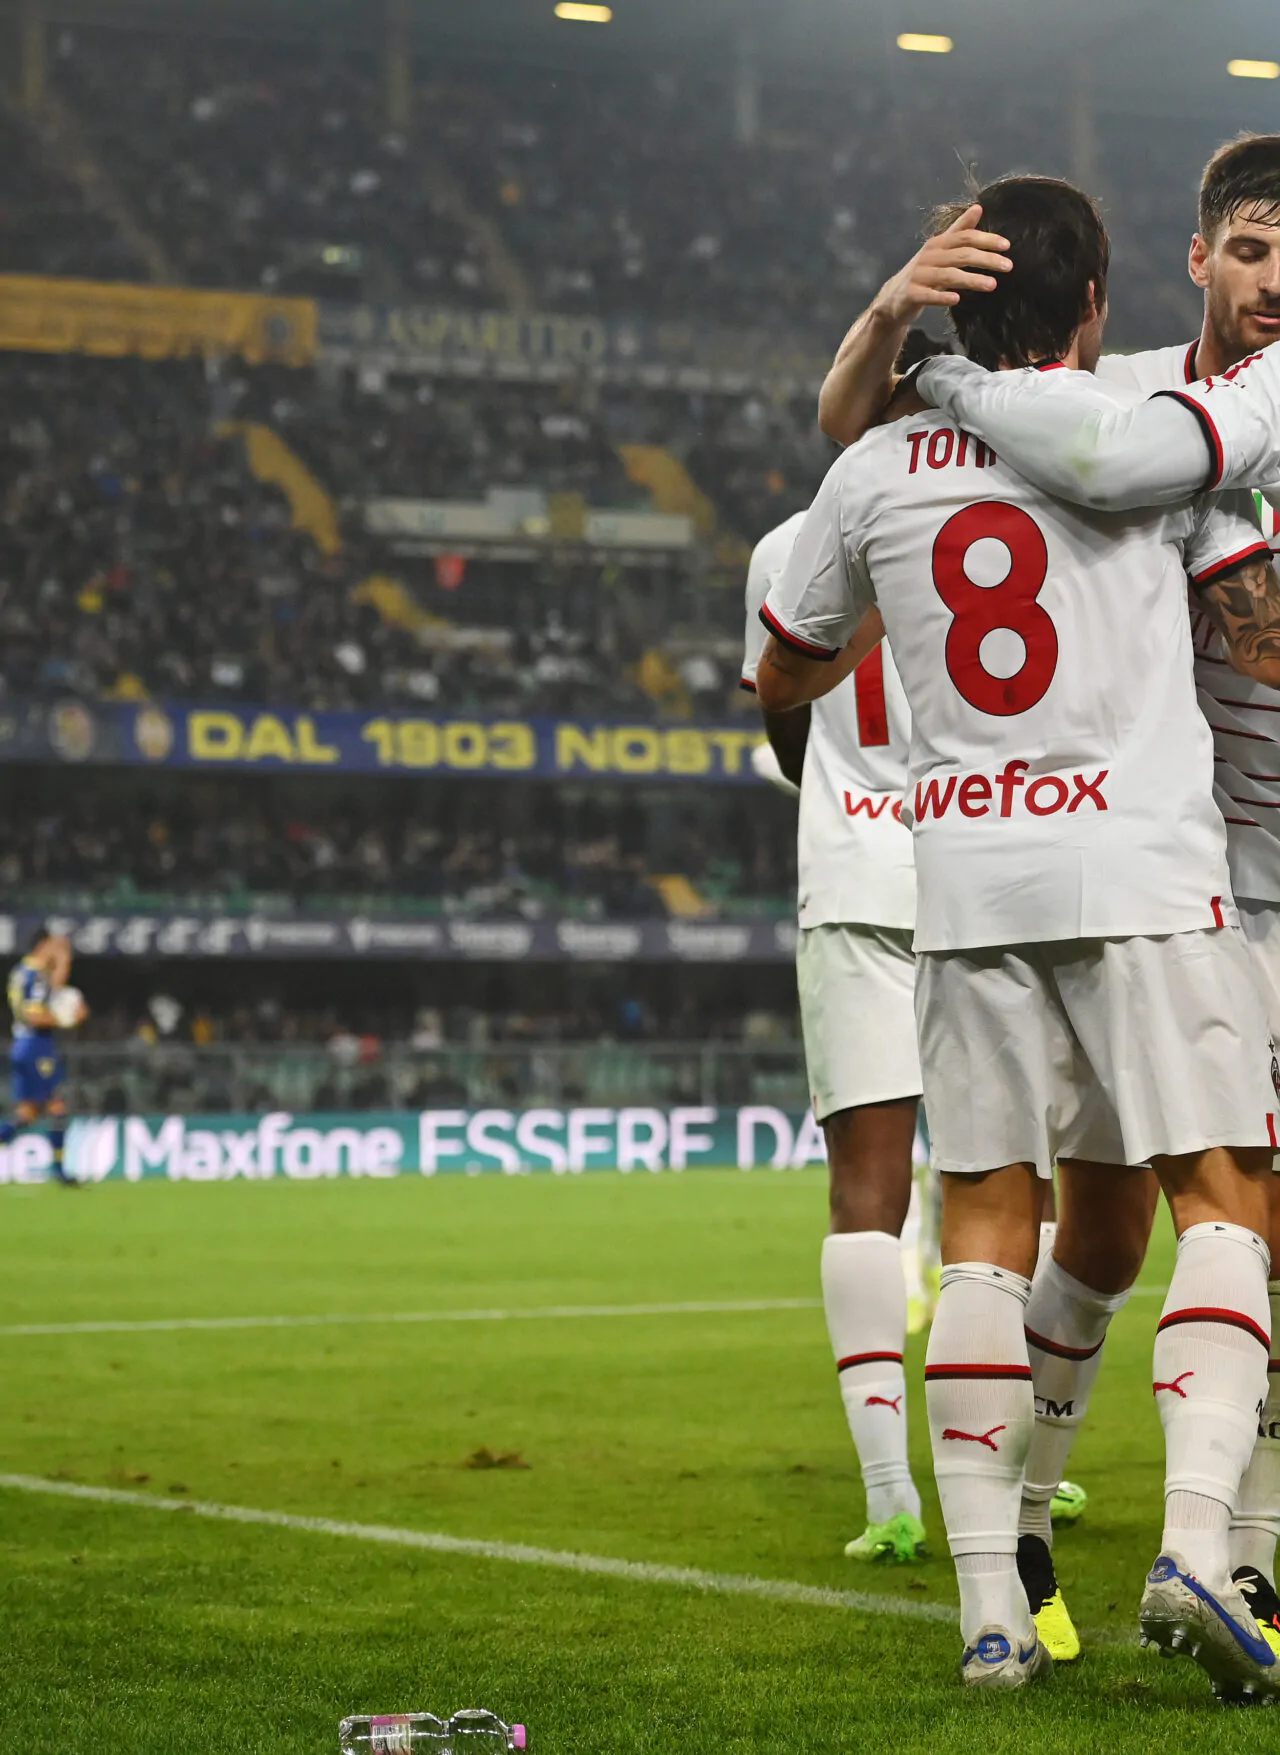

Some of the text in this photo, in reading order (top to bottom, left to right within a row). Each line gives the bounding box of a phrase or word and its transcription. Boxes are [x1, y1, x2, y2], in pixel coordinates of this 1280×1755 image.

[932, 500, 1058, 717] 8
[187, 710, 770, 776] DAL 1903 NOST
[914, 759, 1109, 822] wefox
[124, 1111, 404, 1182] Maxfone
[1034, 1394, 1075, 1418] CM
